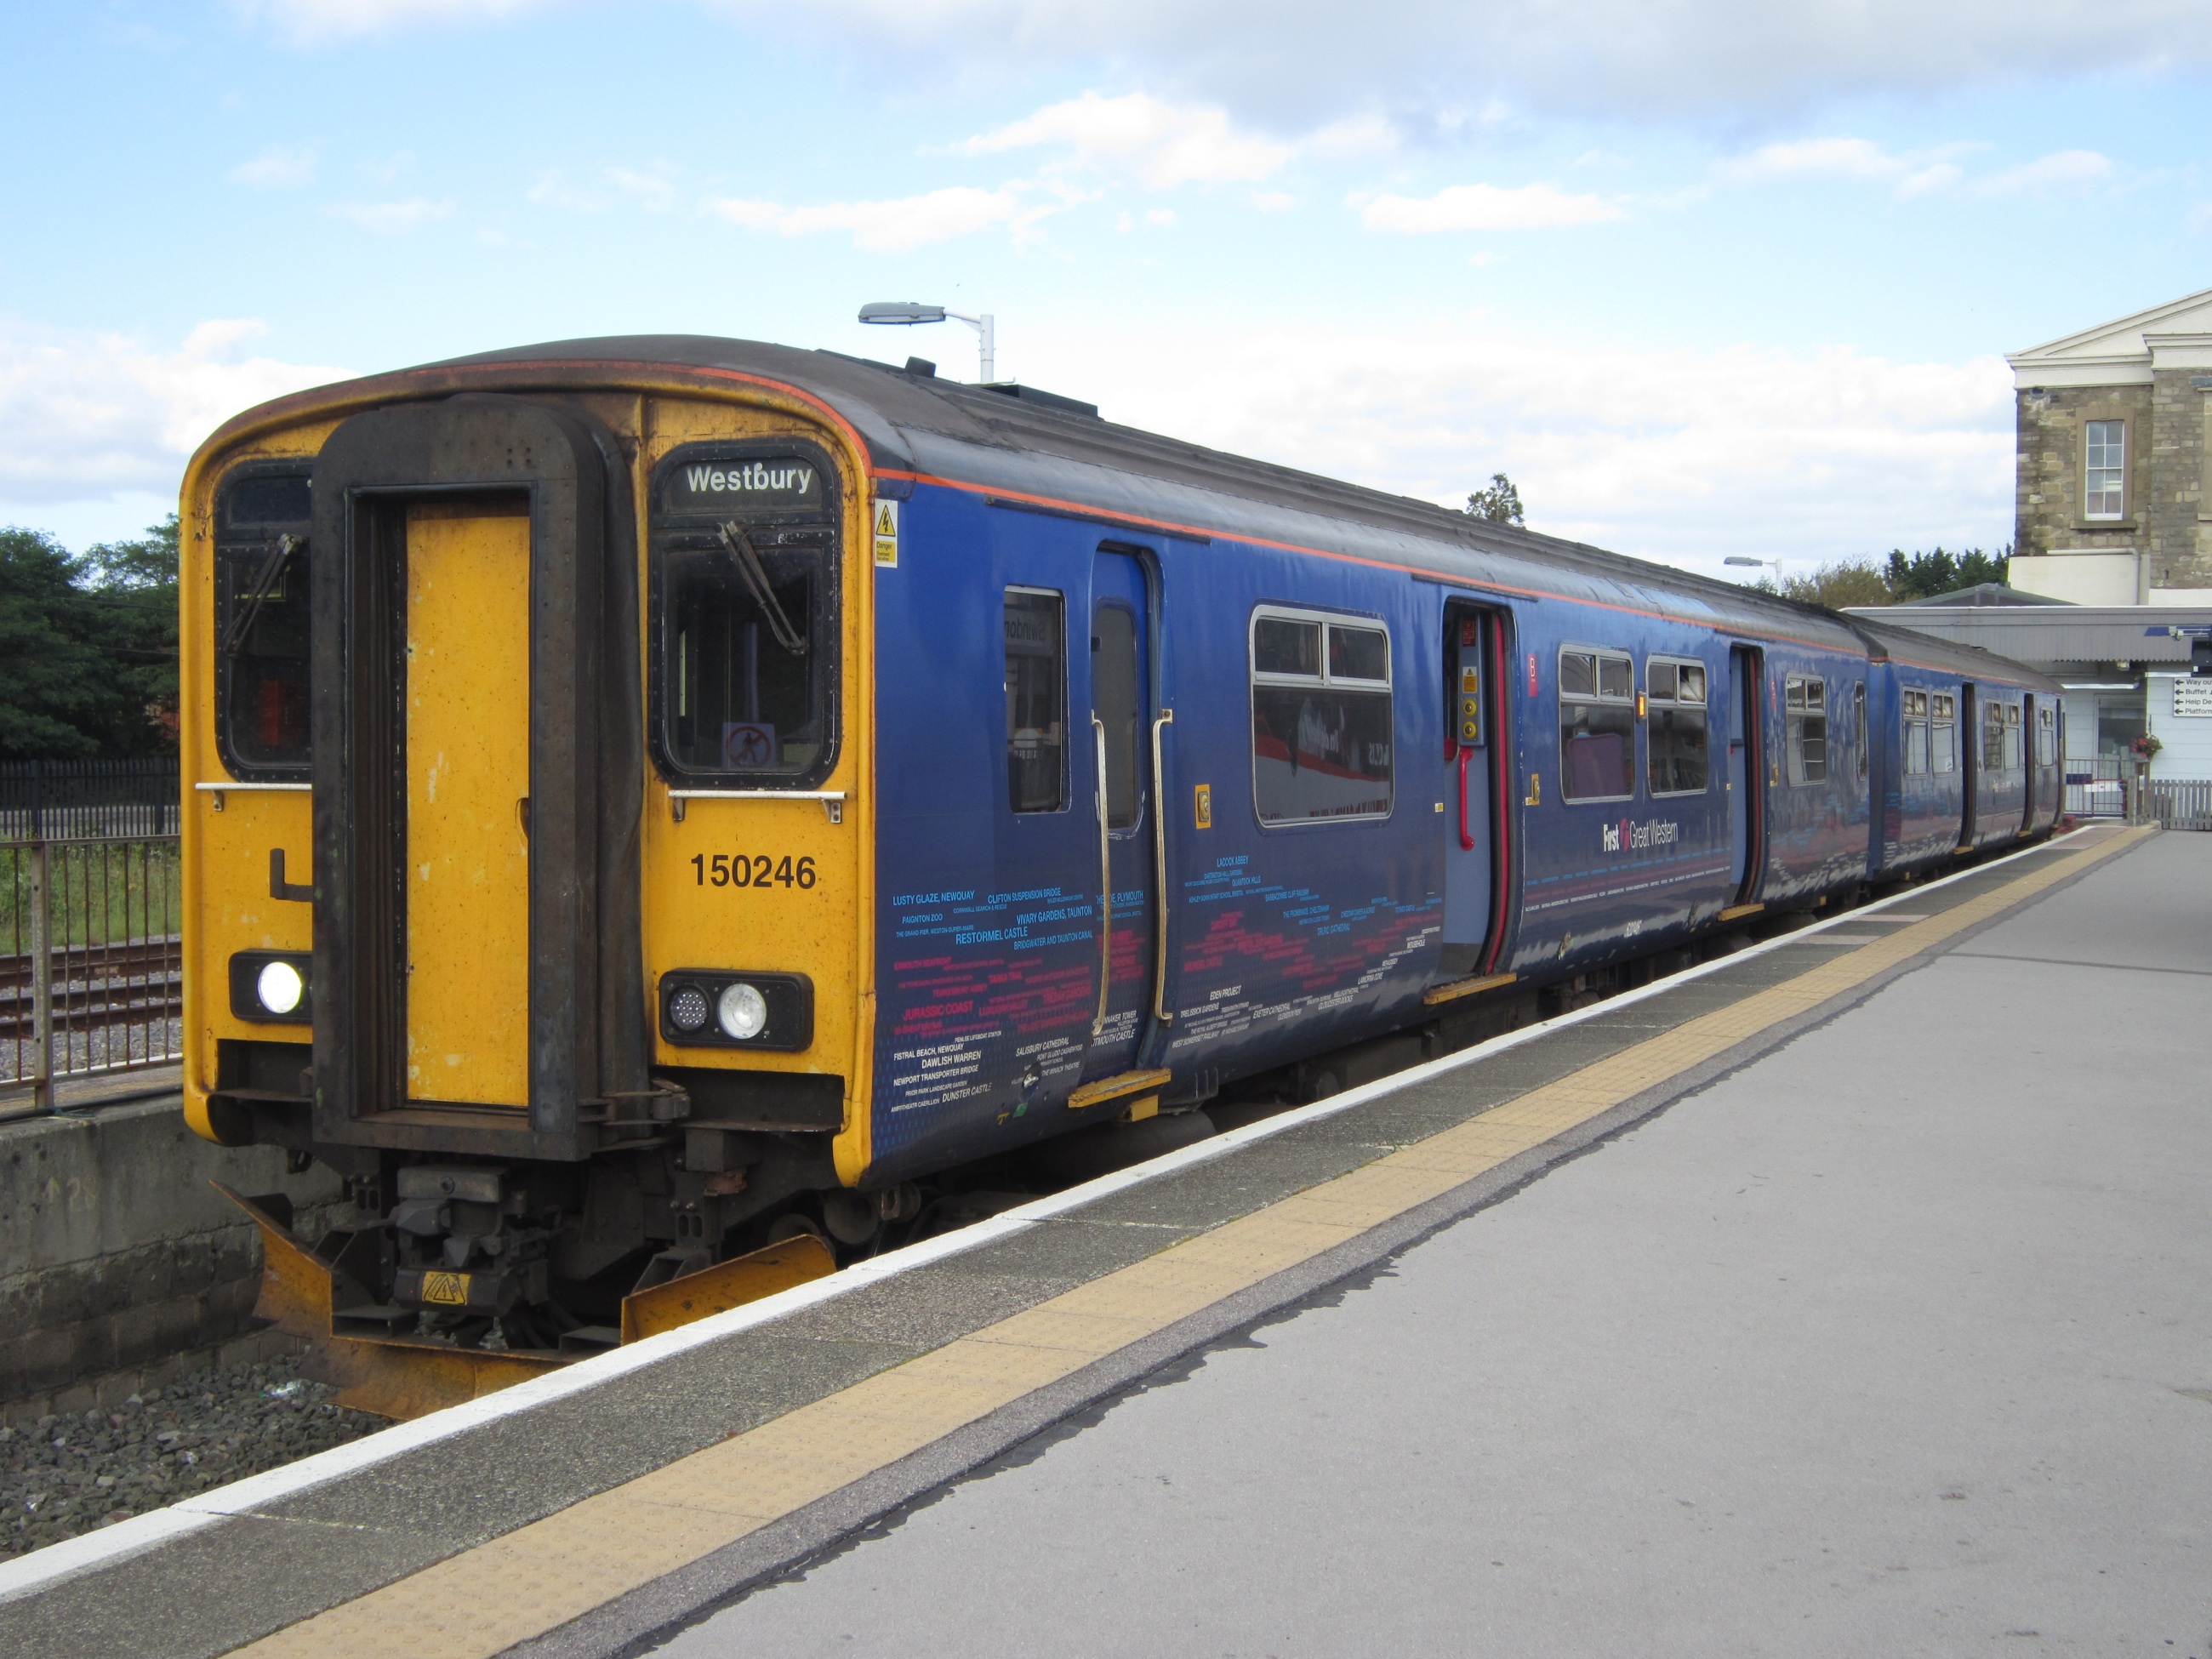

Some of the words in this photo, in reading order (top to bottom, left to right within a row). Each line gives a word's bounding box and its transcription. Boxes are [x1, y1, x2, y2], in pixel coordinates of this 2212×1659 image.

[687, 463, 812, 493] Westbury
[877, 542, 892, 550] Danger
[1603, 824, 1620, 852] First
[1629, 820, 1650, 849] Great
[1649, 818, 1679, 846] Western
[1235, 855, 1249, 865] ABBEY
[691, 853, 816, 889] 150246
[1232, 878, 1251, 887] QUANTOCK
[893, 895, 915, 905] LUSTY
[915, 893, 941, 904] GLAZE,
[941, 890, 975, 902] NEWQUAY
[988, 893, 1011, 904] CLIFTON
[1012, 890, 1043, 902] SUSPENSION
[1043, 887, 1061, 898] BRIDGE
[1118, 890, 1143, 902] PLYMOUTH
[1265, 892, 1287, 902] BABBACOMBE
[1287, 890, 1297, 898] CLIFF
[902, 915, 931, 924] PAIGNTON
[1017, 912, 1038, 925] VIVARY
[1038, 909, 1067, 922] GARDENS,
[1067, 905, 1092, 918] TAUNTON
[931, 925, 974, 934] WESTON-SUPER-MARE
[955, 930, 1004, 944] RESTORMEL
[1004, 926, 1028, 939] CASTLE
[1317, 926, 1329, 936] TRURO
[1331, 922, 1350, 934] CATHEDRAL
[1014, 938, 1046, 949] BRIDGWATER
[1046, 936, 1057, 944] AND
[1057, 932, 1078, 943] TAUNTON
[1078, 931, 1092, 940] CANAL
[1407, 939, 1426, 949] MOUSEHOLE
[1358, 974, 1374, 985] LAMORNA
[1375, 972, 1383, 980] COVE
[1210, 991, 1222, 1001] EDEN
[1222, 985, 1241, 998] PROJECT
[1341, 995, 1354, 1006] DOCKS
[904, 1005, 944, 1021] JURASSIC
[945, 1001, 973, 1015] COAST
[1122, 1011, 1137, 1019] TOWER
[1181, 1007, 1202, 1018] TRELISSICK
[1202, 1002, 1219, 1012] GARDENS
[1253, 1008, 1269, 1019] EXETER
[1269, 1002, 1291, 1015] CATHEDRAL
[1116, 1029, 1136, 1042] CASTLE
[1172, 1040, 1183, 1048] WEST
[1183, 1035, 1203, 1046] SOMERSET
[1203, 1030, 1220, 1040] RAILWAY
[894, 1052, 915, 1061] FISTRAL
[916, 1048, 937, 1058] BEACH,
[938, 1043, 964, 1053] NEWQUAY
[1016, 1044, 1042, 1057] SALISBURY
[1042, 1037, 1069, 1050] CATHEDRAL
[922, 1056, 953, 1069] DAWLISH
[953, 1051, 982, 1063] WARREN
[1064, 1062, 1080, 1070] THEATRE
[893, 1075, 920, 1086] NEWPORT
[921, 1069, 960, 1081] TRANSPORTER
[961, 1064, 979, 1075] BRIDGE
[929, 1084, 952, 1093] LANDSCAPE
[943, 1087, 971, 1103] DUNSTER
[971, 1082, 993, 1096] CASTLE
